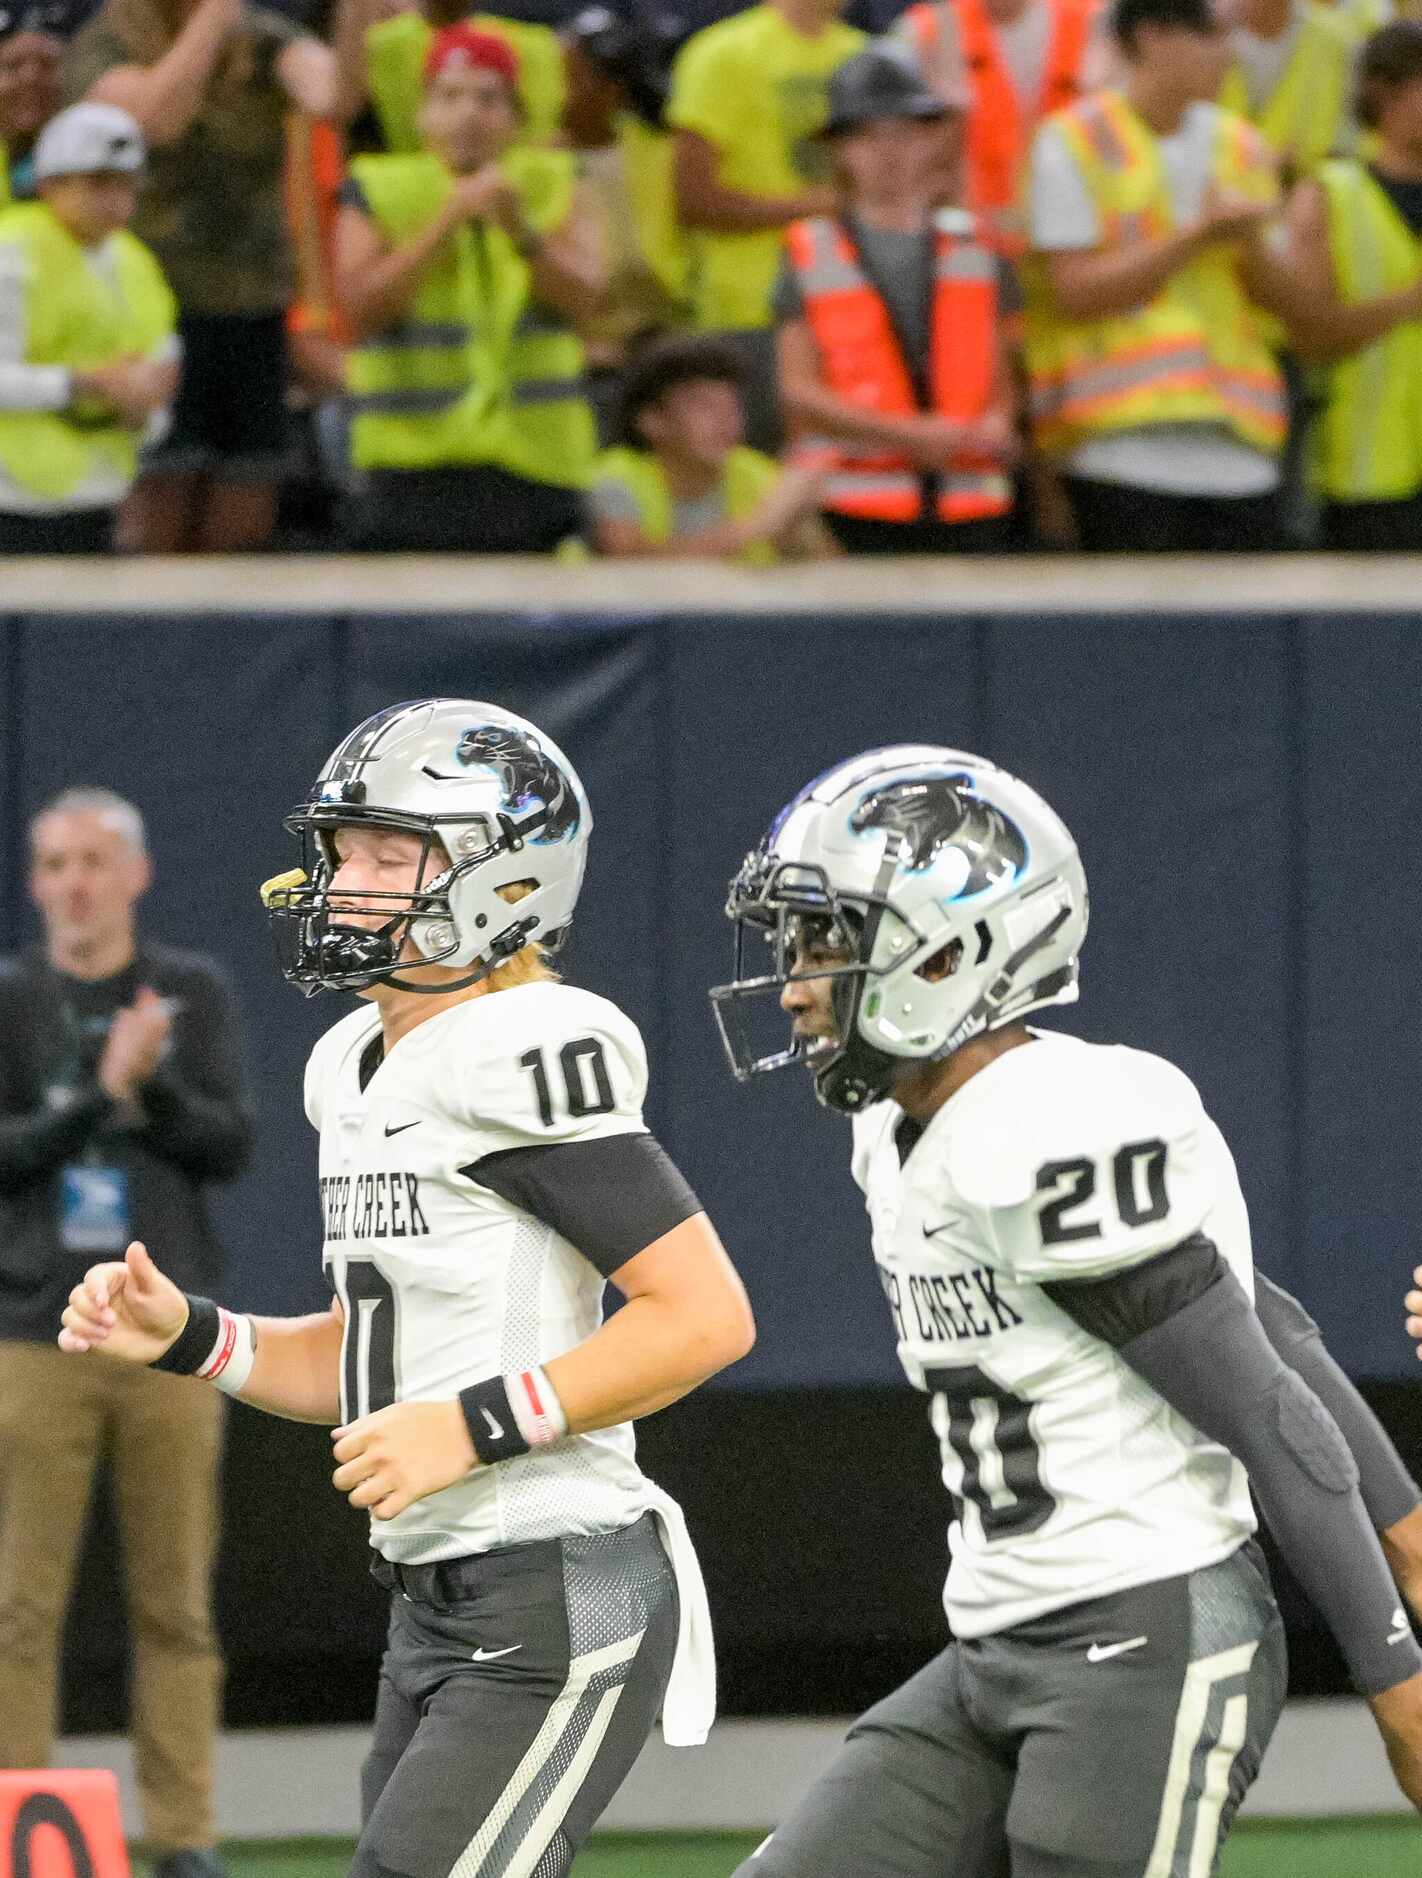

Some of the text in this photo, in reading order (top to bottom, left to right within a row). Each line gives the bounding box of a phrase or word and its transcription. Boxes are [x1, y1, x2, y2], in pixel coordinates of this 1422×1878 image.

[519, 1036, 616, 1128] 10
[353, 1172, 429, 1239] CREEK
[1035, 1140, 1171, 1246] 20
[909, 1264, 1024, 1341] CREEK
